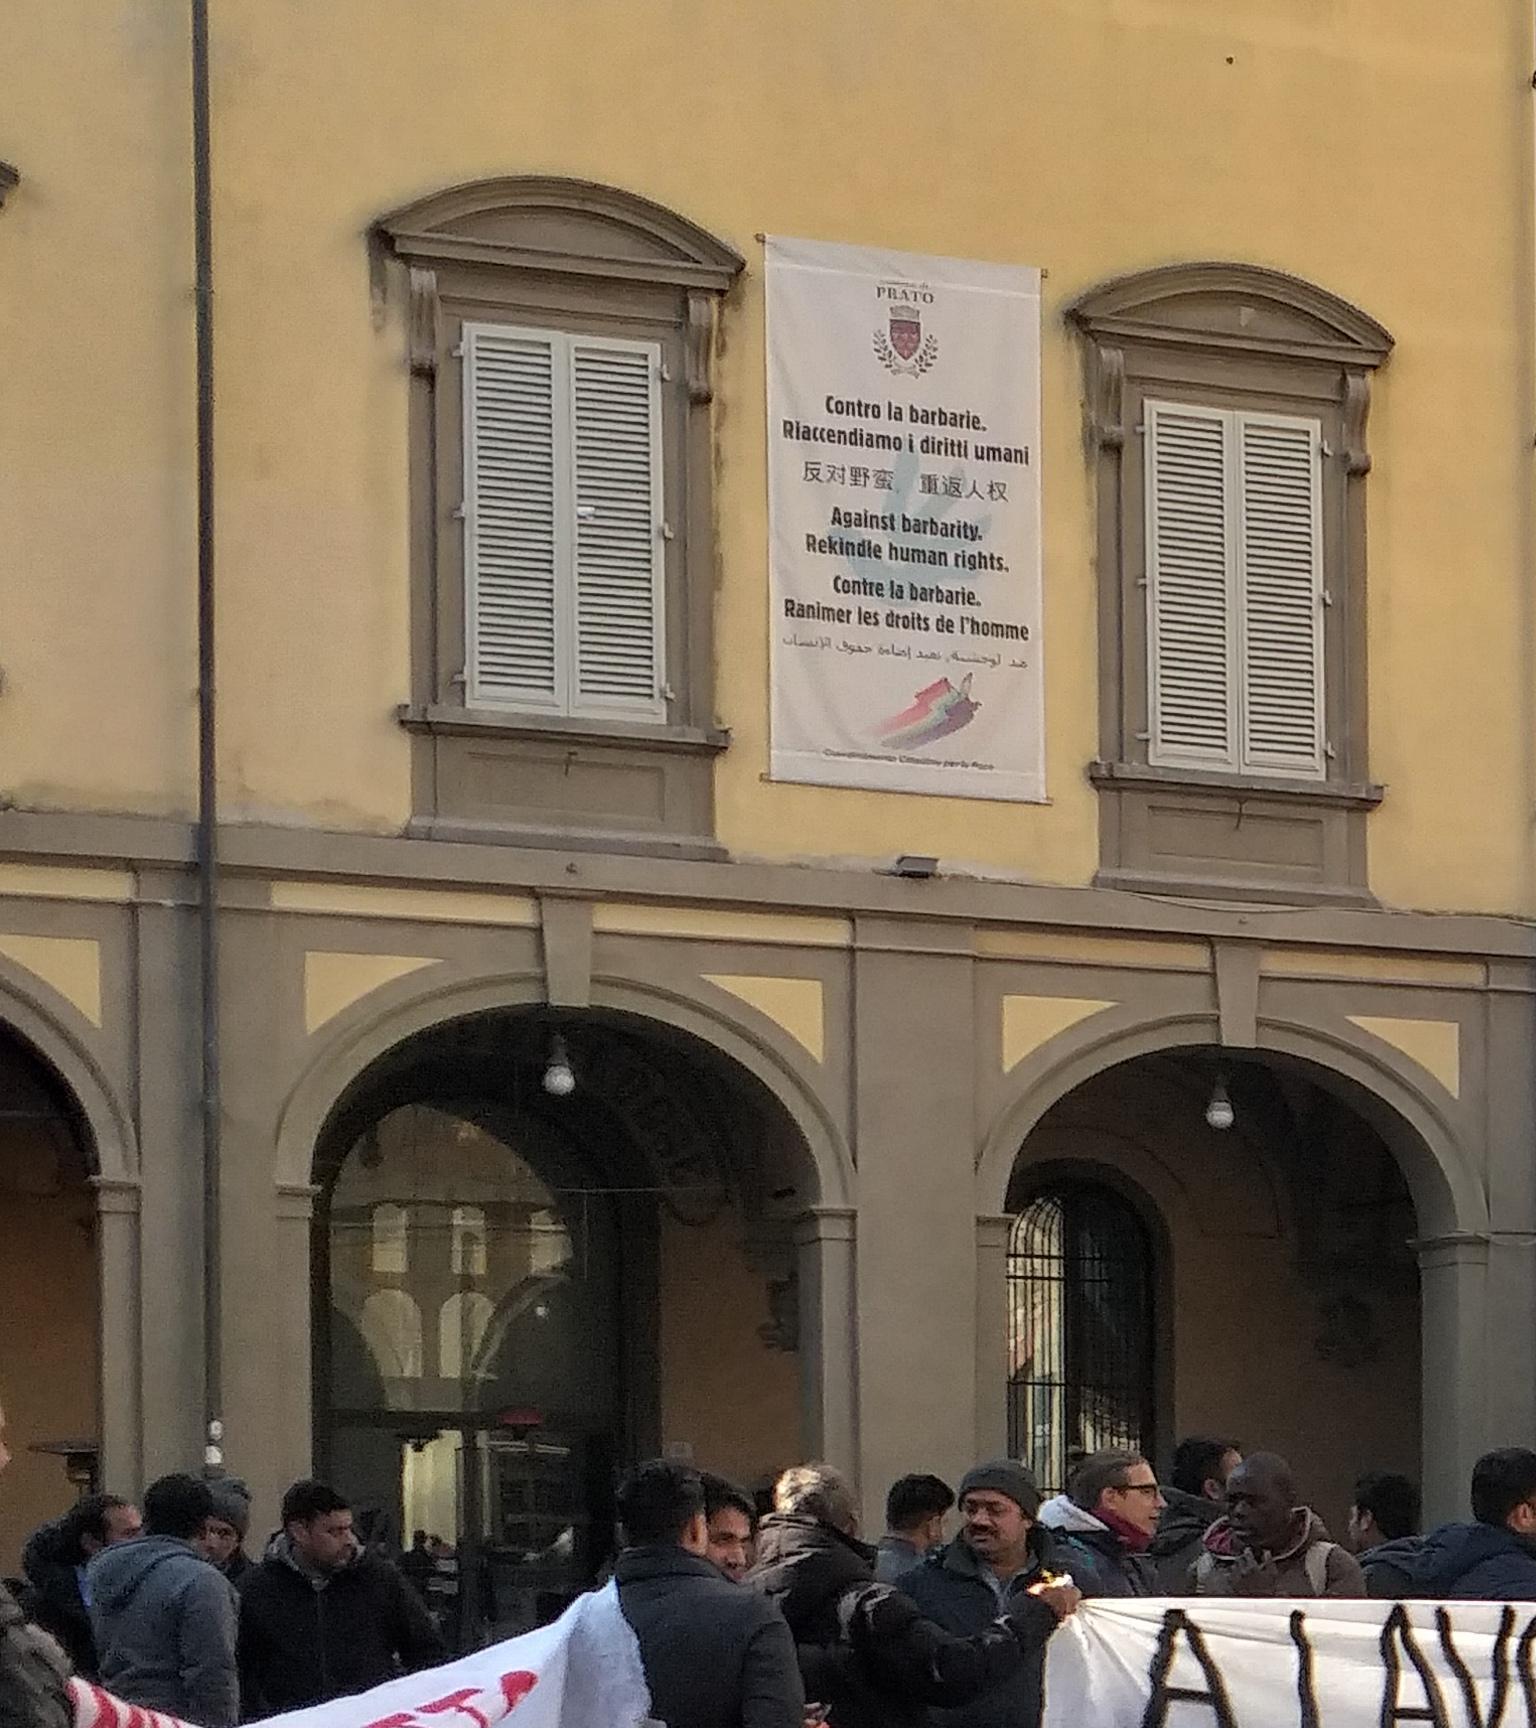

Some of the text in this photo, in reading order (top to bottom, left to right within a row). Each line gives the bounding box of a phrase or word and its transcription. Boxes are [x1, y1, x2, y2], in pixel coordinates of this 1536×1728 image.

[876, 286, 934, 304] PRATO
[825, 395, 987, 432] Contro la barbarie.
[782, 419, 1029, 466] Riaccendiamo i diritti umani
[831, 506, 983, 542] Against barbarity.
[805, 533, 1009, 573] Rekindle human rights.
[833, 574, 982, 607] Contre la barbarie.
[783, 597, 1029, 642] Ranimer les droits de l'homme
